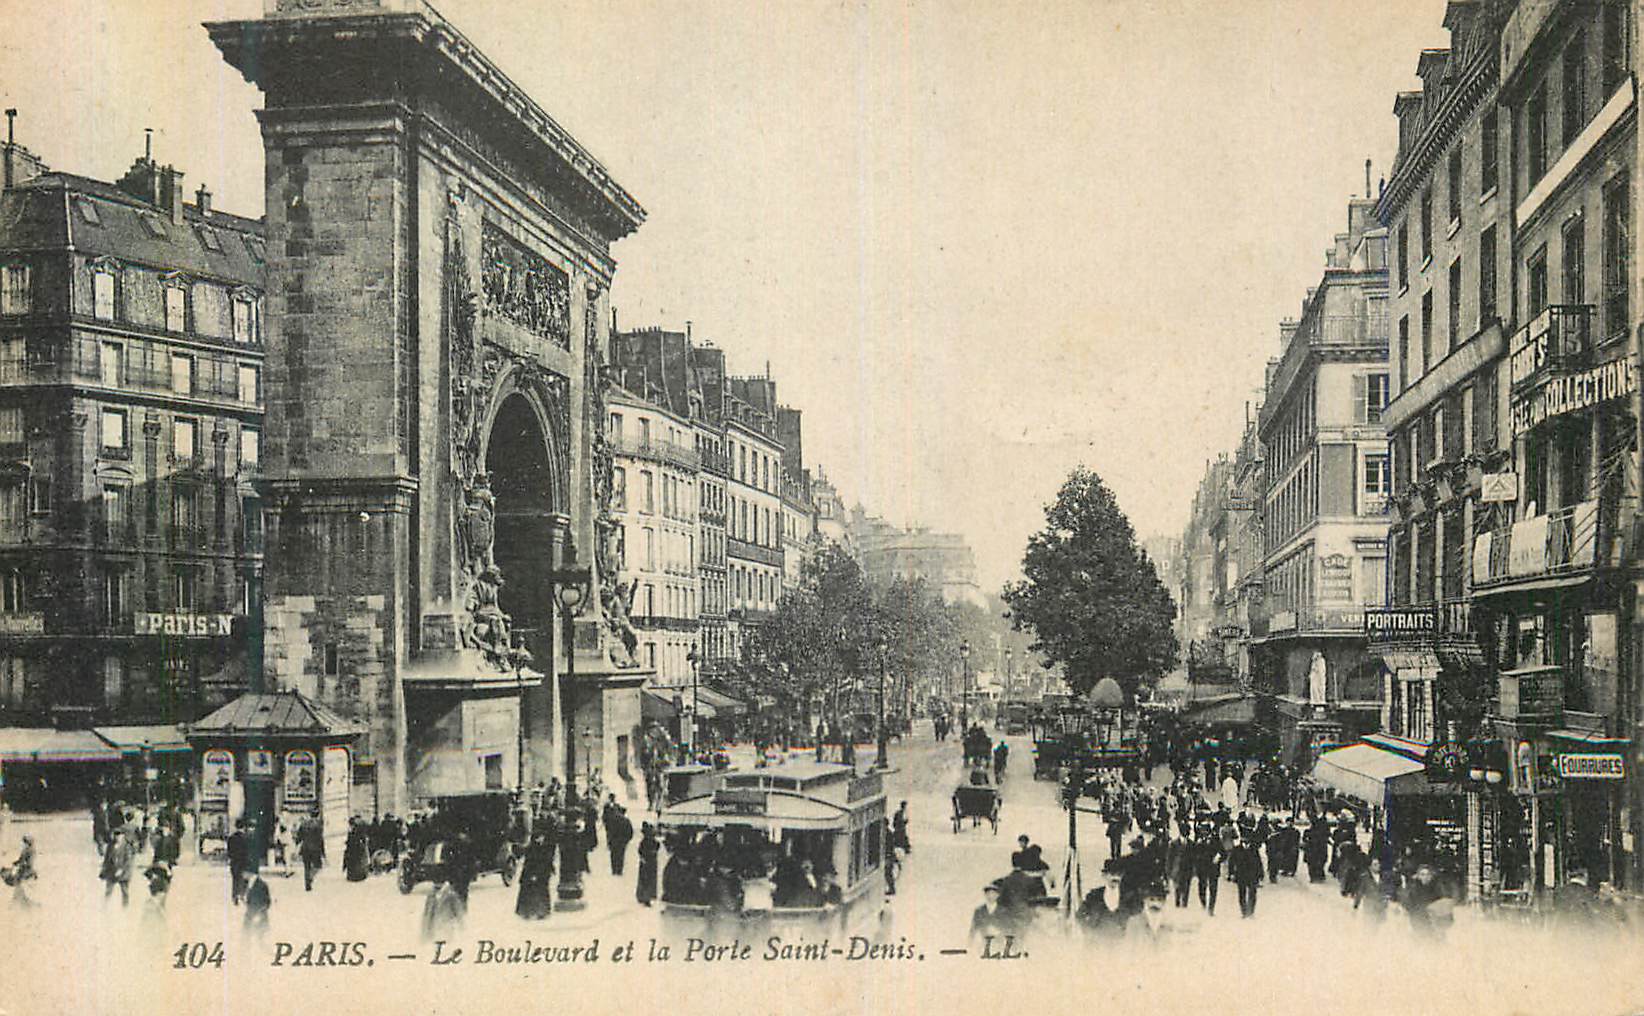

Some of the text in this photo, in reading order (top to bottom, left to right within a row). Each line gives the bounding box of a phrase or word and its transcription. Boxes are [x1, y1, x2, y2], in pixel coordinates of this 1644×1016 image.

[1546, 357, 1637, 417] COLLECTIONS
[1367, 612, 1434, 630] PORTRAITS
[1560, 755, 1623, 775] FOURRURES
